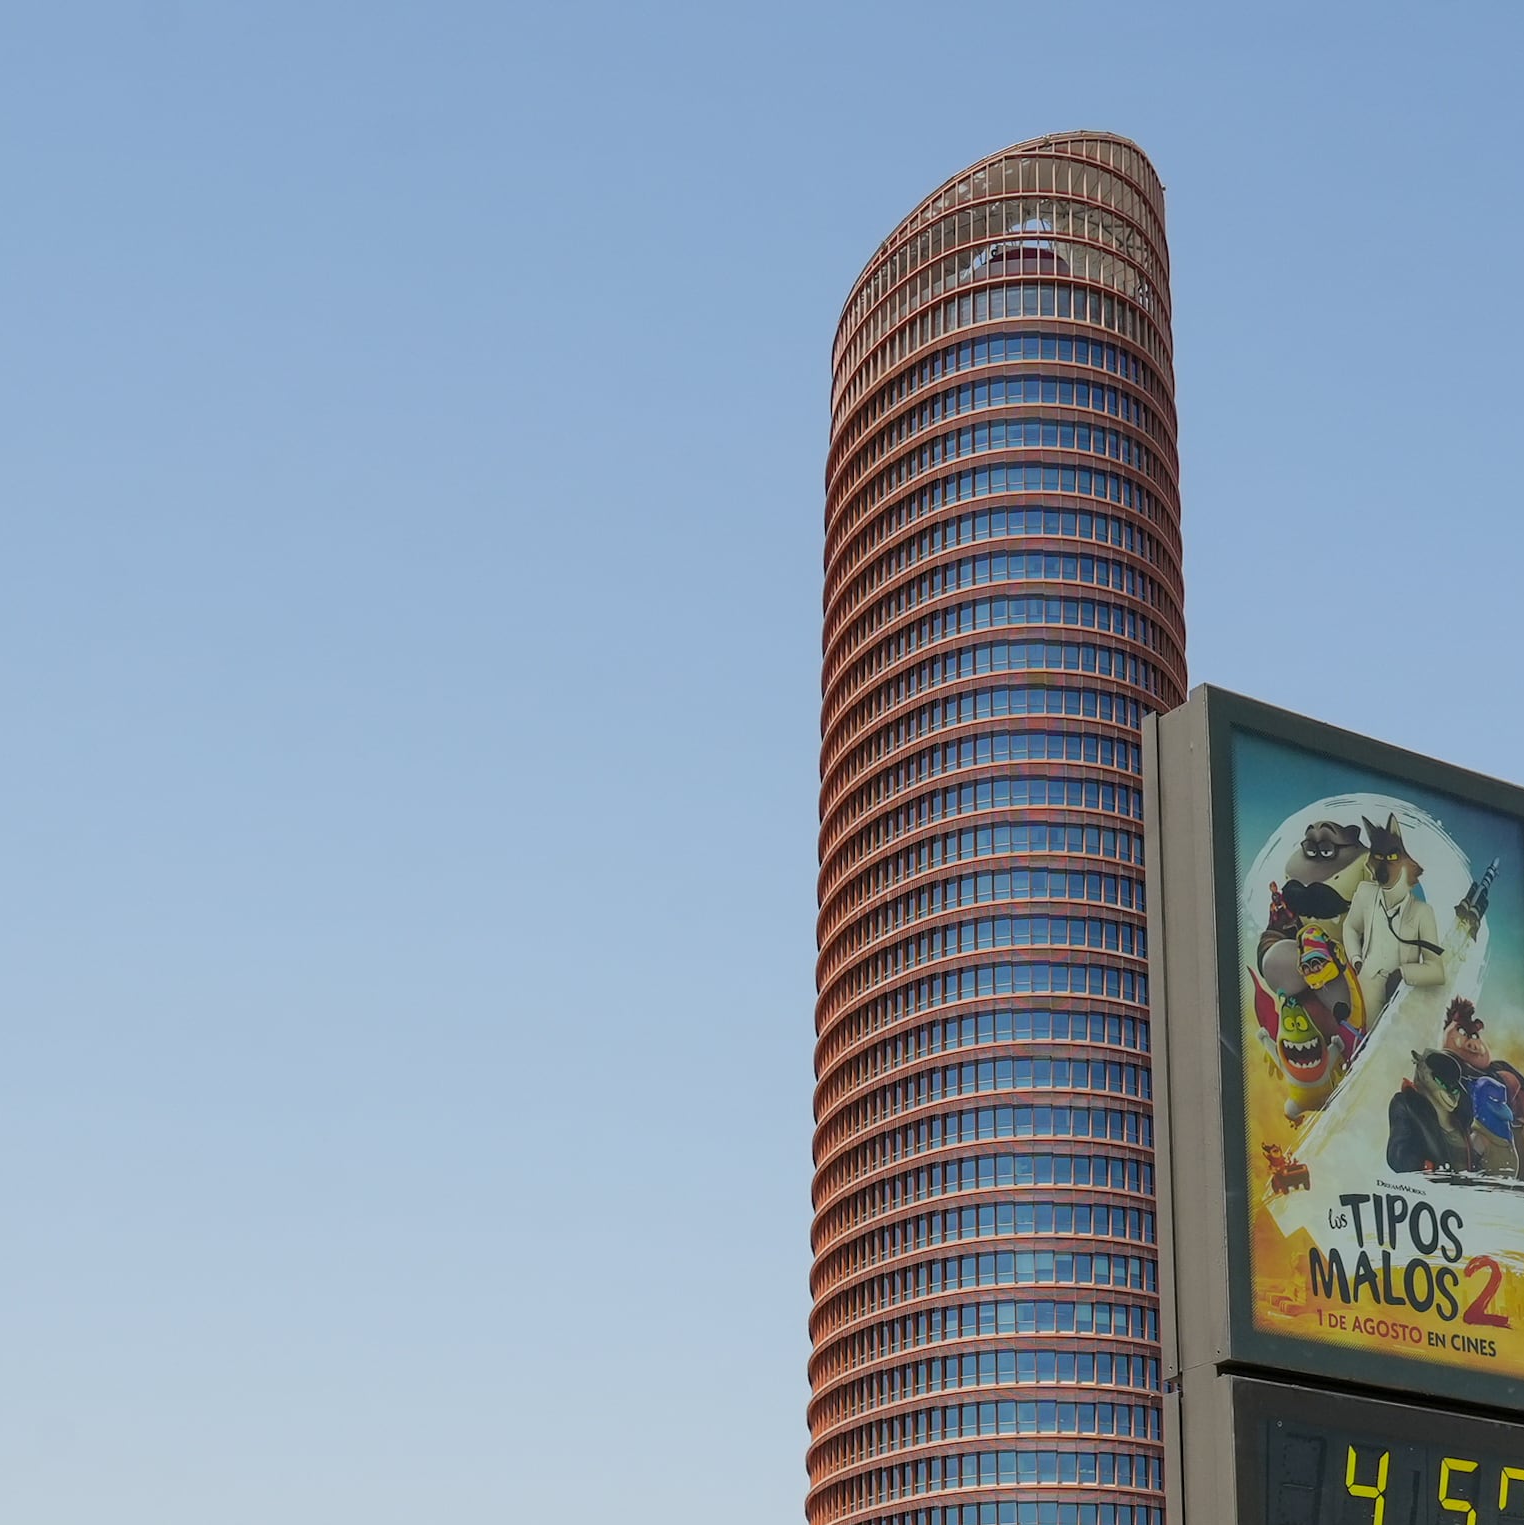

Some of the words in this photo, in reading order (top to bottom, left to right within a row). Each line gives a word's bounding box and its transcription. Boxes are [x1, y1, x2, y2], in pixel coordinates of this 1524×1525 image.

[1339, 1193, 1464, 1263] TIPOS
[1309, 1247, 1460, 1321] MALOS
[1463, 1255, 1513, 1330] 2
[1316, 1308, 1325, 1327] 1
[1328, 1313, 1347, 1331] DE
[1351, 1316, 1423, 1344] AGOSTO
[1427, 1331, 1447, 1349] EN
[1450, 1335, 1498, 1358] CINES
